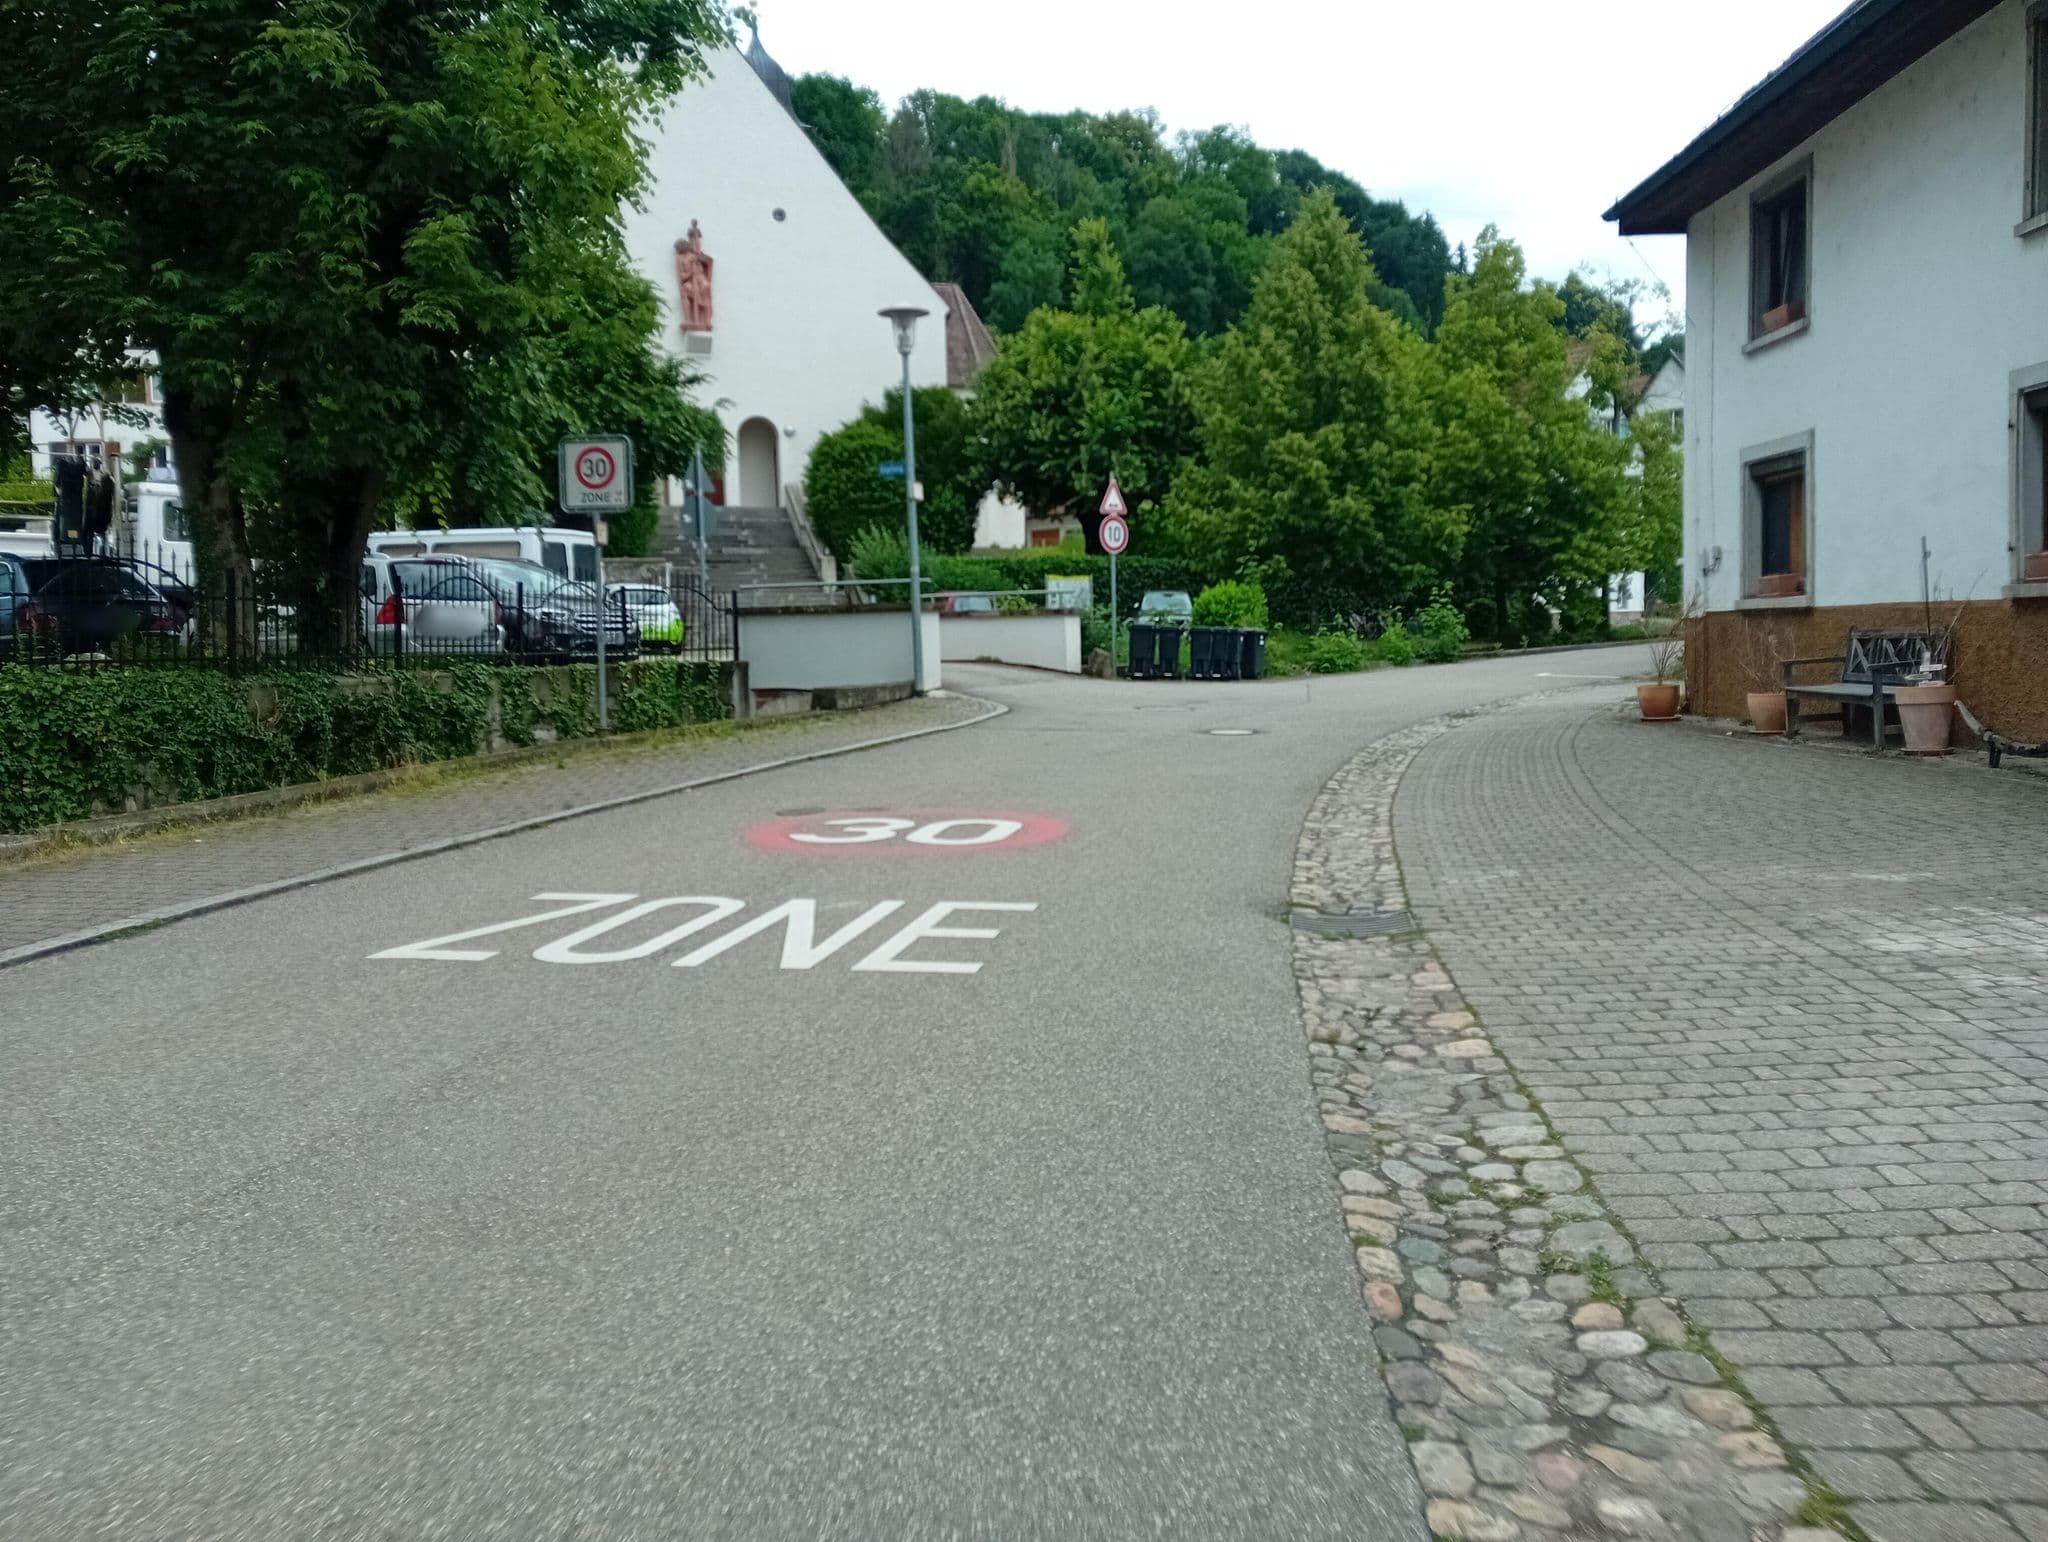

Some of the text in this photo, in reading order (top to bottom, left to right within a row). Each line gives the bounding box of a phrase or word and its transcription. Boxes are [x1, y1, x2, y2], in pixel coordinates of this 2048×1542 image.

[583, 458, 606, 477] 30
[582, 492, 610, 503] ZONE
[1108, 526, 1121, 542] 10
[788, 818, 1023, 844] 30
[365, 892, 1039, 973] ZONE
